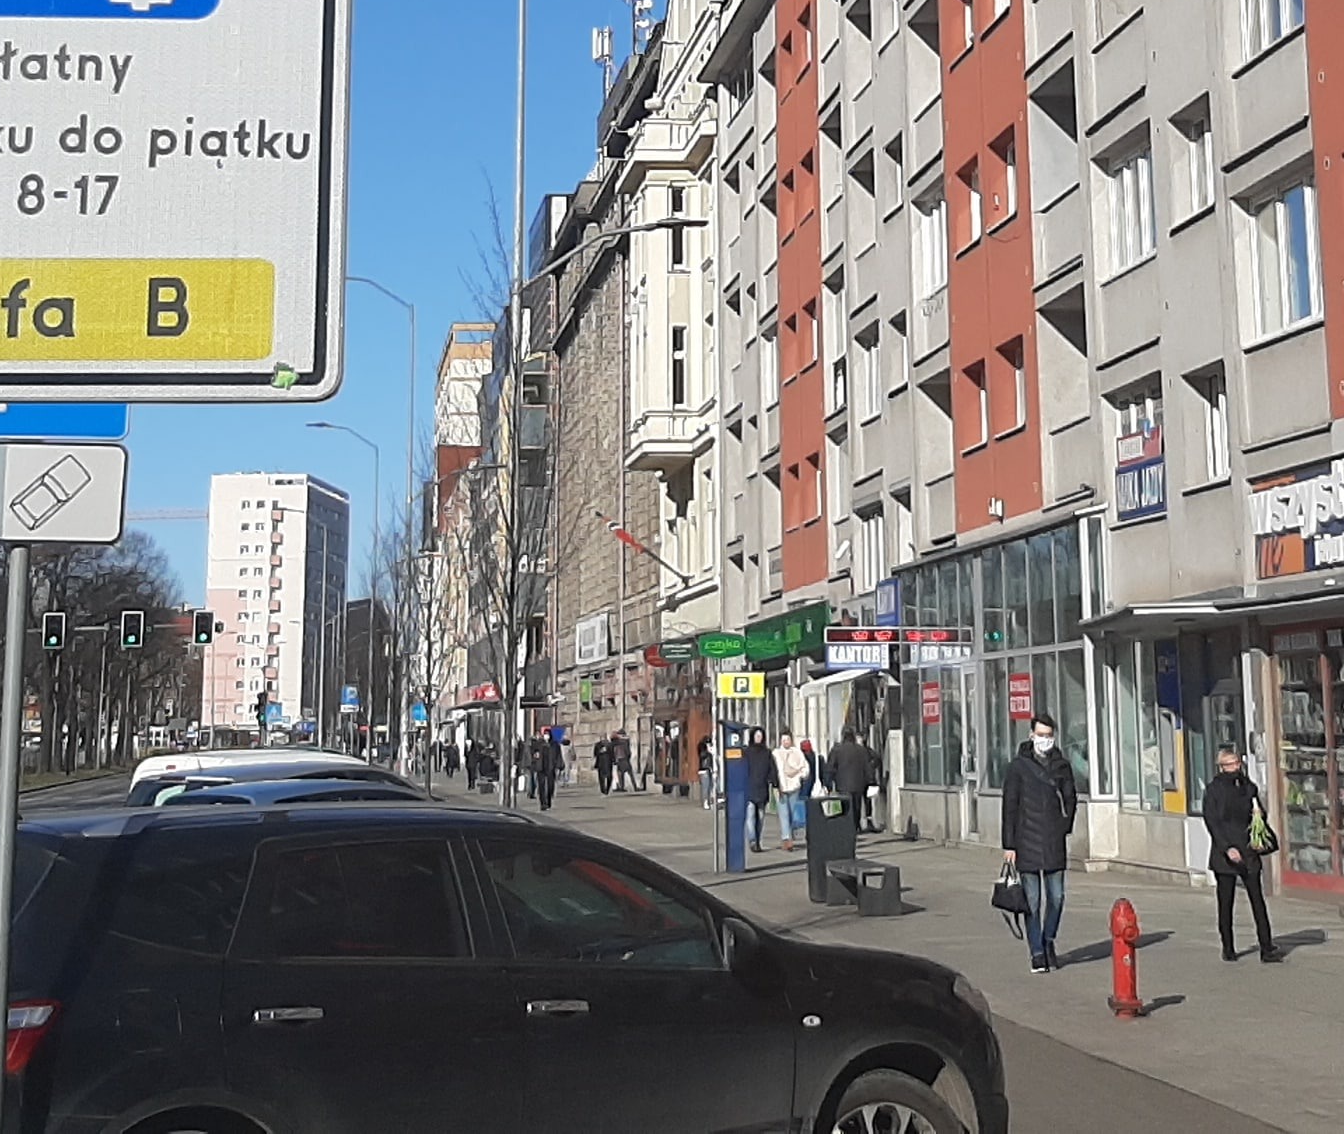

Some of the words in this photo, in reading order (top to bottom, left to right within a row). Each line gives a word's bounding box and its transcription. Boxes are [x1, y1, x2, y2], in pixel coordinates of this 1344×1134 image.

[59, 114, 123, 155] do
[149, 116, 311, 170] piątku
[17, 174, 119, 216] 8-17
[147, 278, 189, 337] B
